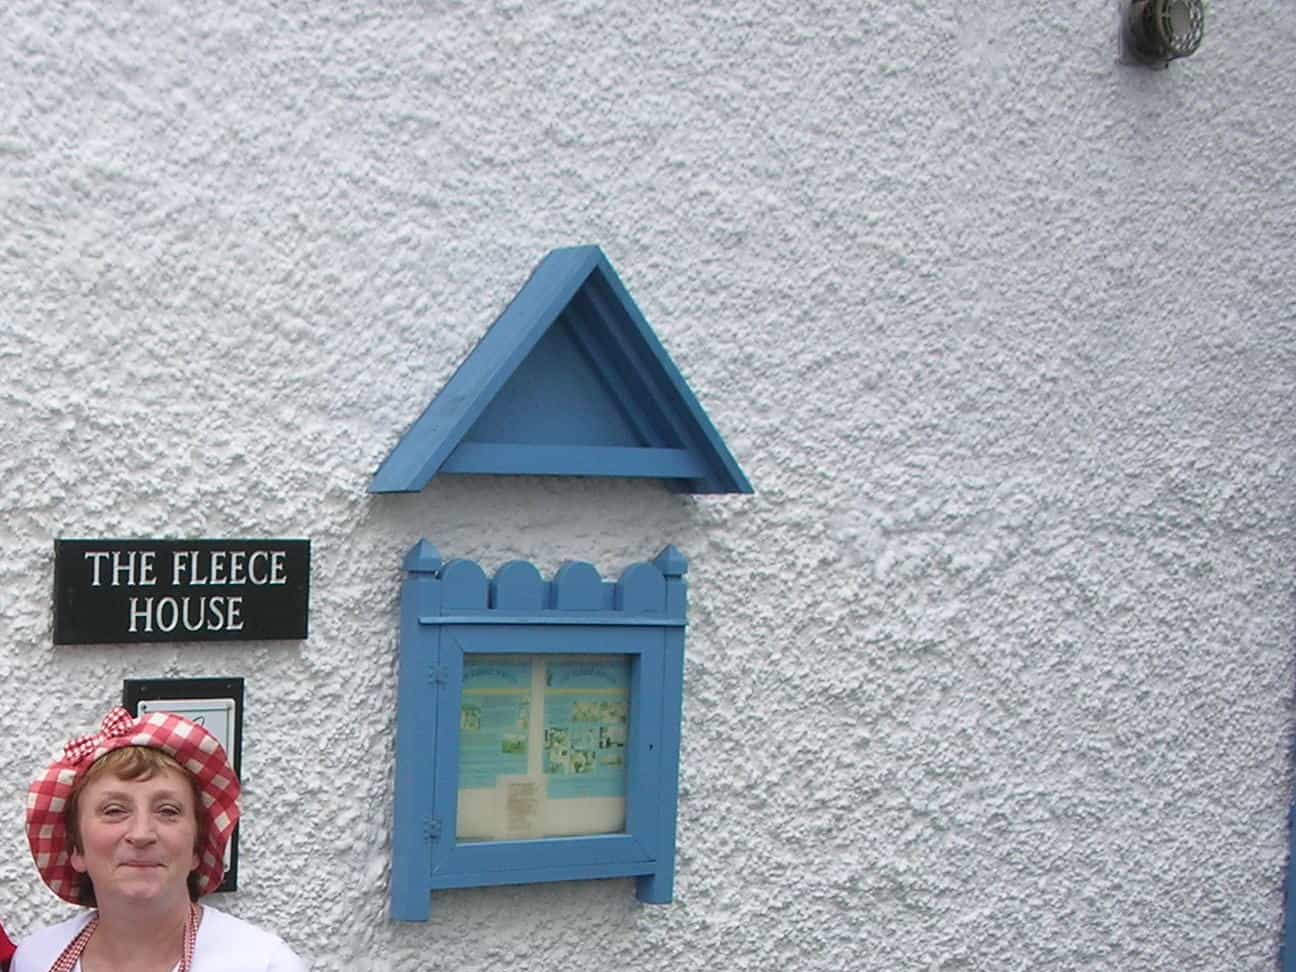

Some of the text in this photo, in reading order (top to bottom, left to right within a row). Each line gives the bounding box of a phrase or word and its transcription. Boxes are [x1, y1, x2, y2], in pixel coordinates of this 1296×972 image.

[84, 550, 288, 586] THE FLEECE
[127, 595, 245, 632] HOUSE
